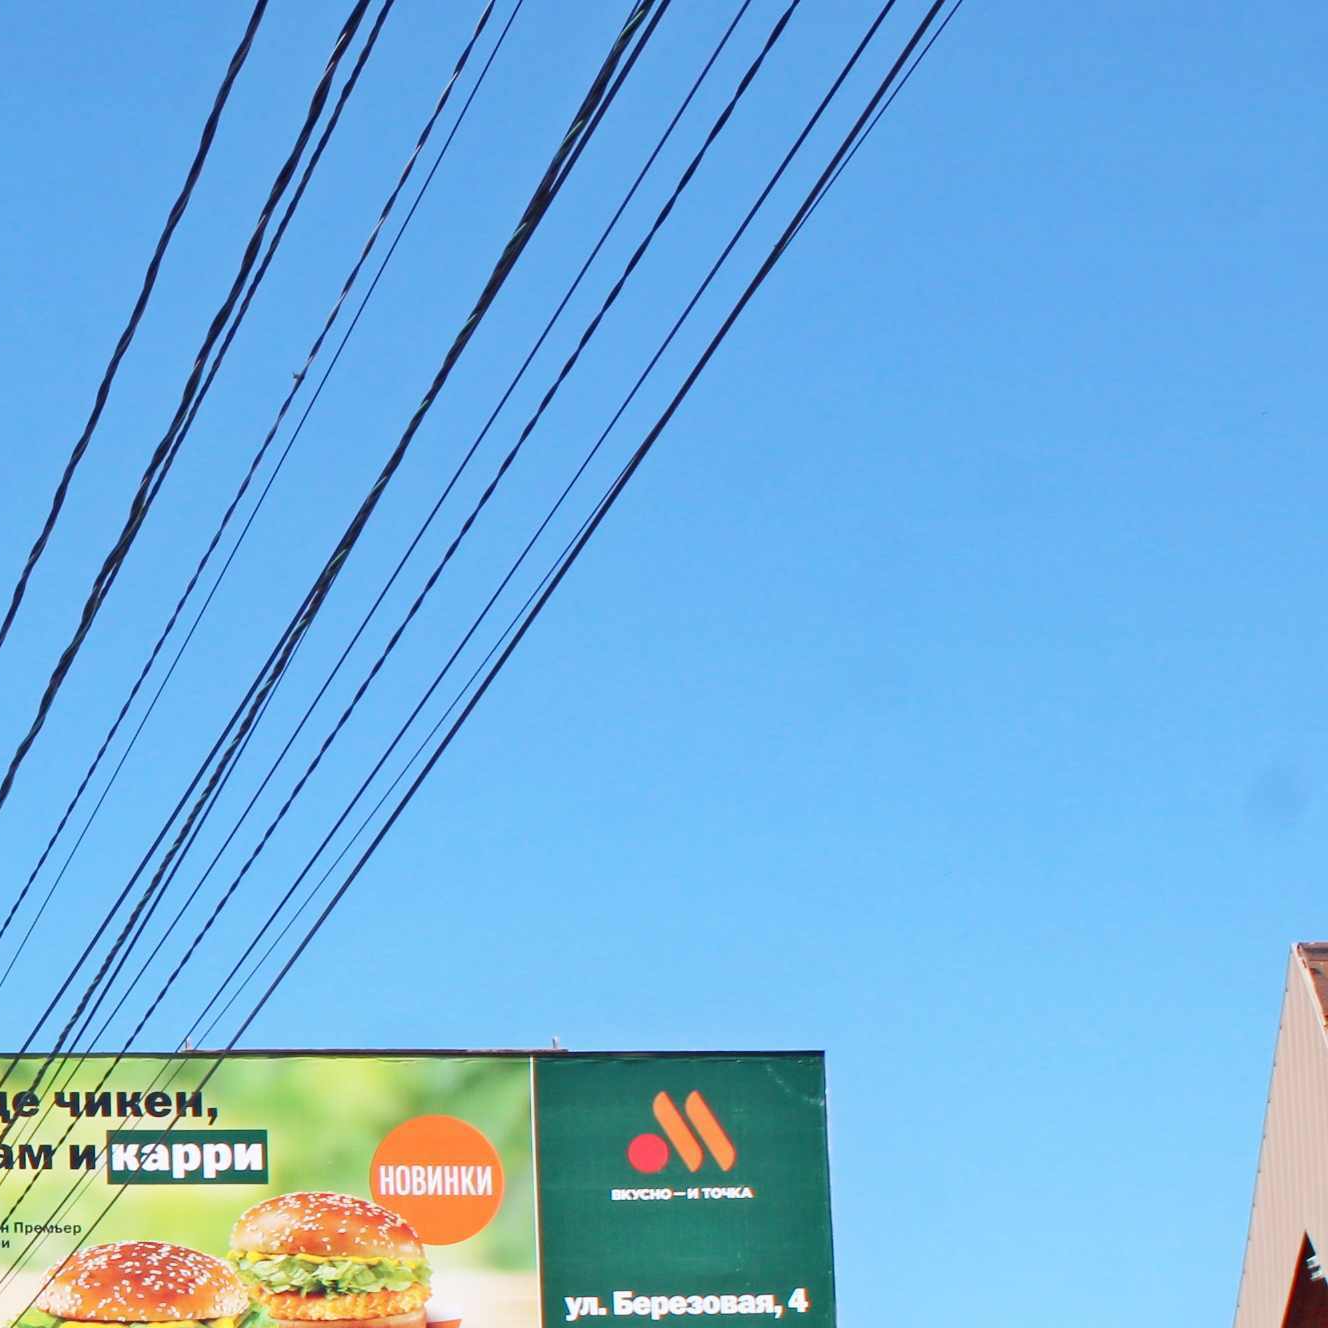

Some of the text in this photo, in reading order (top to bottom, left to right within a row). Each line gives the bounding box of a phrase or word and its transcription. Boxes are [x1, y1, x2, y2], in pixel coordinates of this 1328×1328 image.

[54, 1091, 218, 1126] чикен,
[69, 1144, 96, 1170] и
[111, 1142, 264, 1179] карри
[379, 1165, 493, 1196] НОВИНКИ
[611, 1188, 672, 1201] ВКУСНО
[687, 1187, 699, 1199] И
[701, 1187, 753, 1199] ТОЧКА
[13, 1221, 82, 1236] Премьер
[564, 1288, 809, 1321] ул. Березовая, 4
